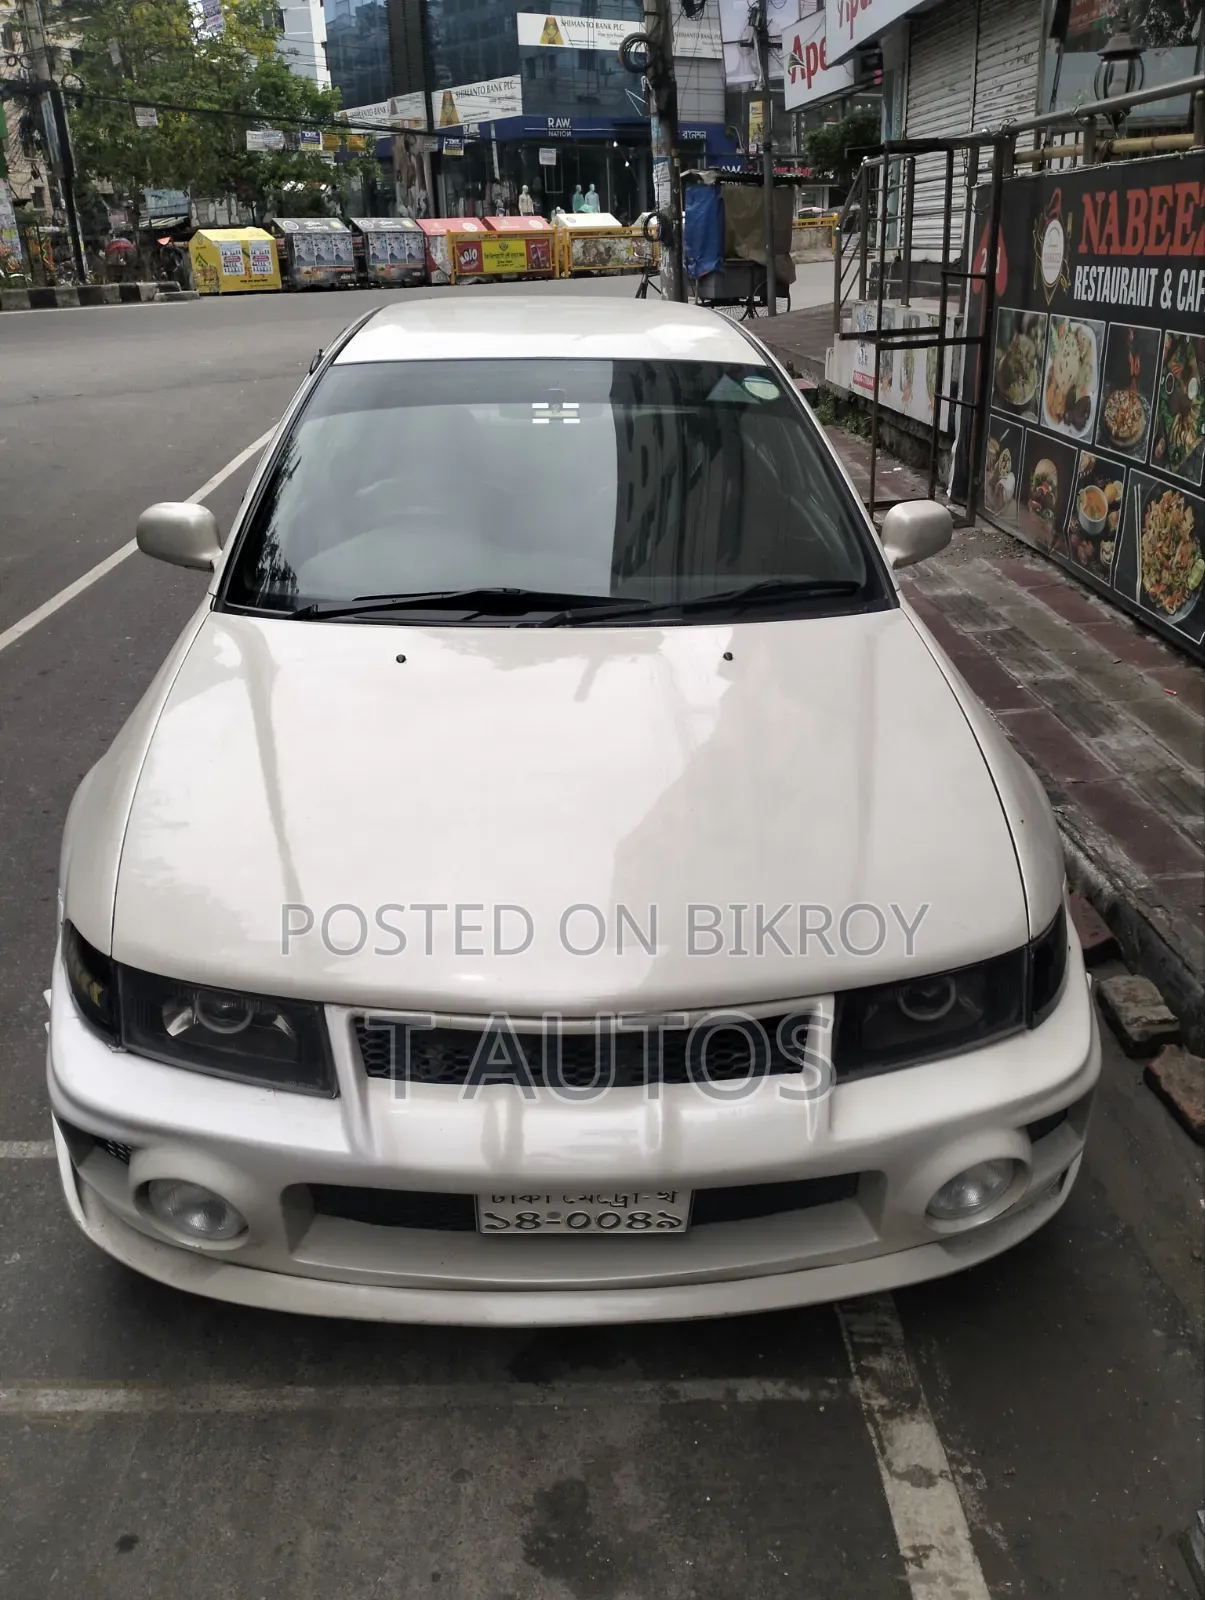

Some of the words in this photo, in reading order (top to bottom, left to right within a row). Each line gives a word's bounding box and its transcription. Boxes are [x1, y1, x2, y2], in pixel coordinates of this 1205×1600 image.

[561, 19, 594, 29] SHIMANTO
[595, 22, 612, 30] BANK
[787, 35, 828, 89] Ape
[455, 85, 485, 99] SHIMANTO
[487, 83, 502, 94] BANK
[1078, 182, 1205, 256] NABEE
[1074, 265, 1159, 305] RESTAURANT
[1160, 268, 1173, 310] &
[1177, 269, 1205, 313] CAF
